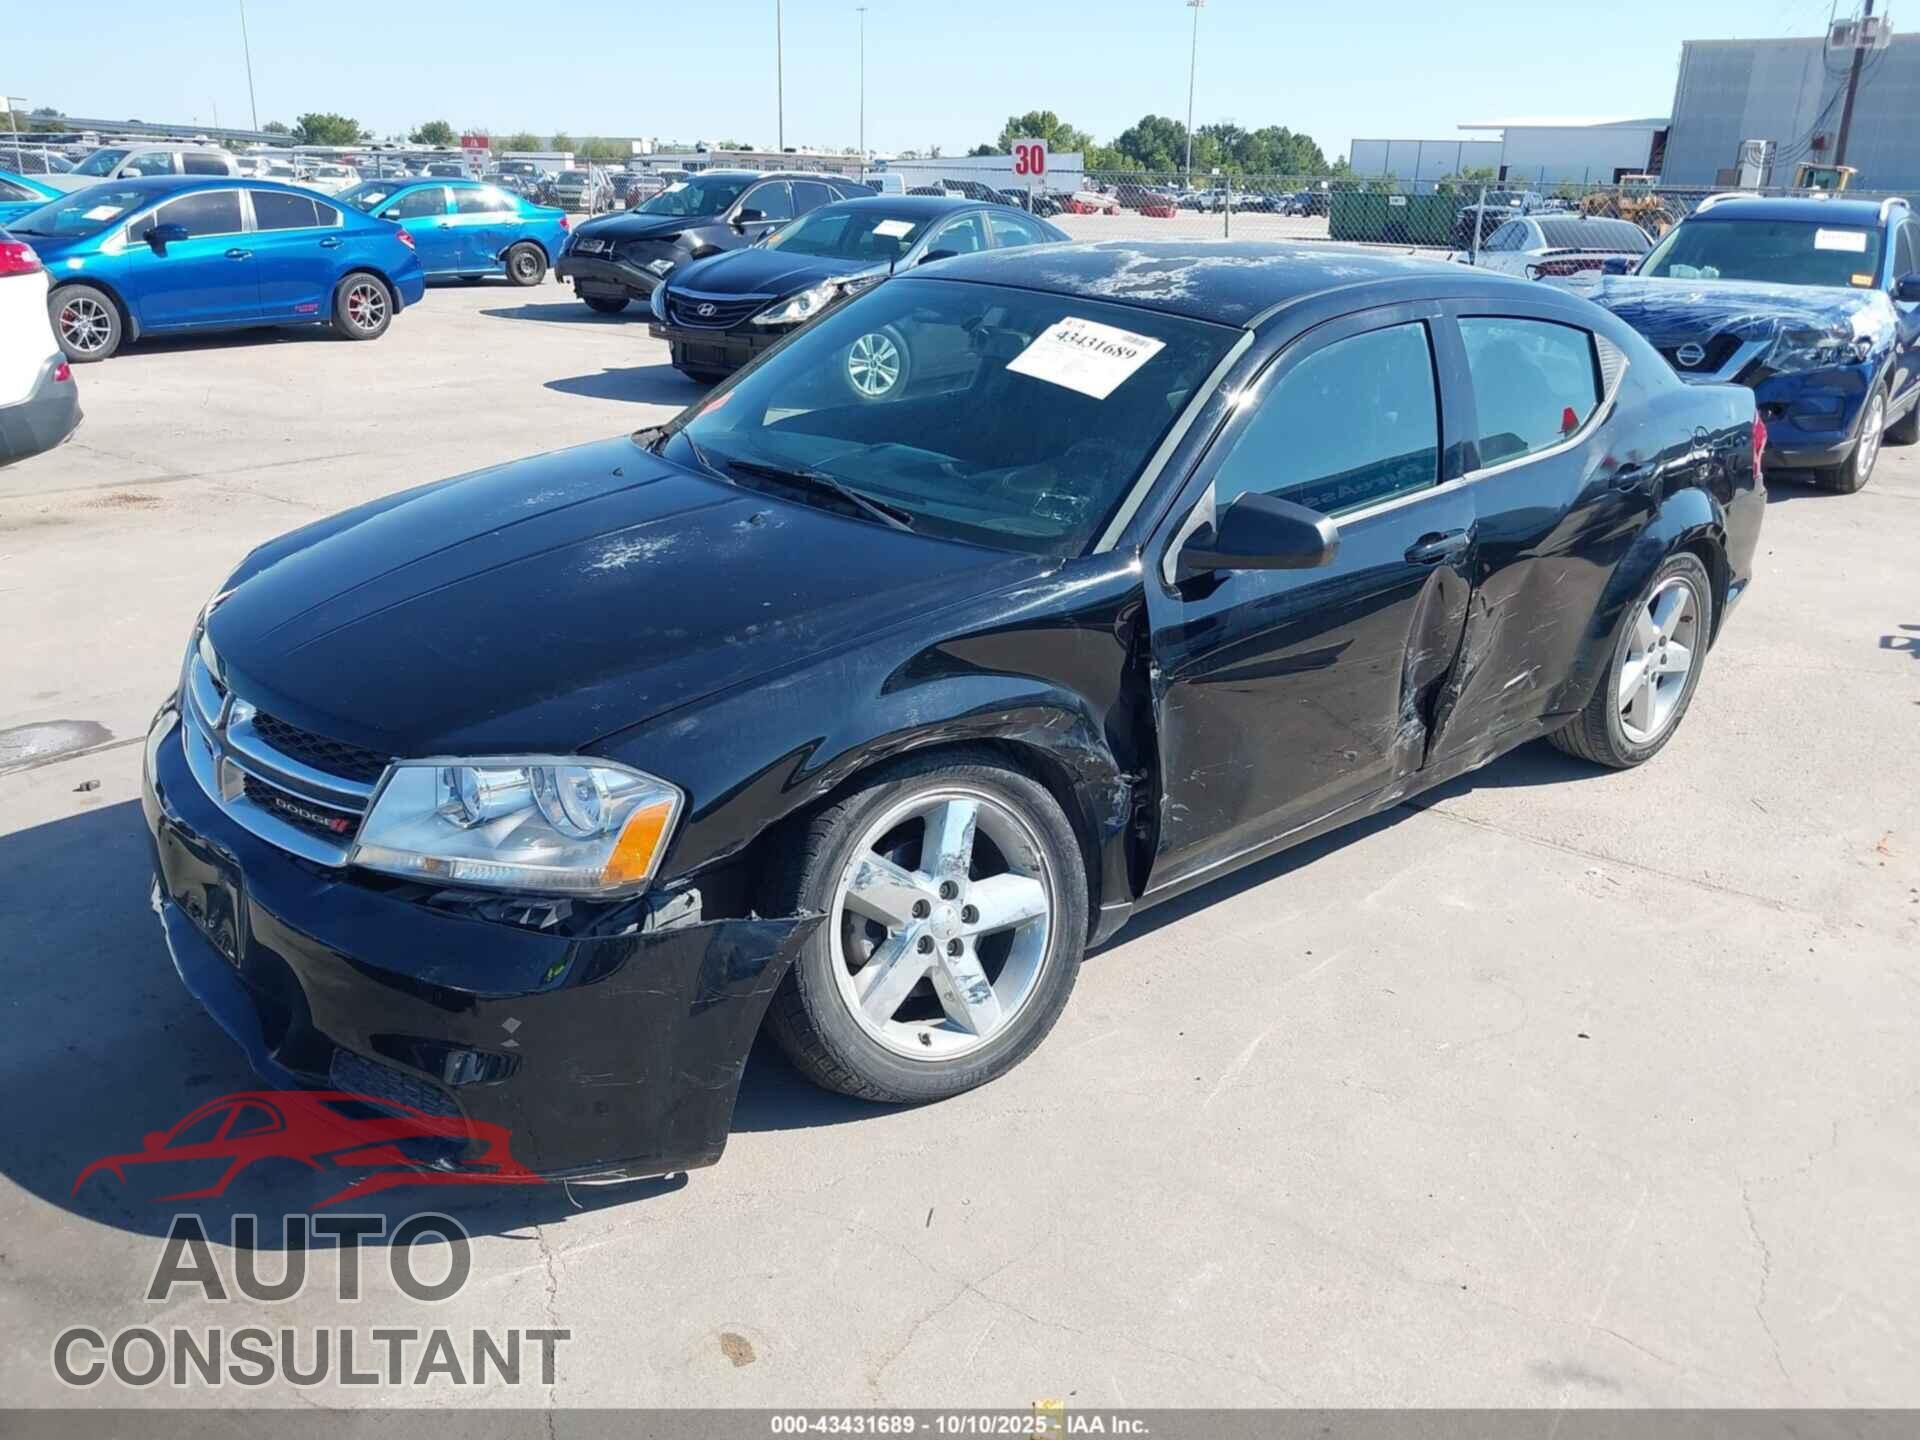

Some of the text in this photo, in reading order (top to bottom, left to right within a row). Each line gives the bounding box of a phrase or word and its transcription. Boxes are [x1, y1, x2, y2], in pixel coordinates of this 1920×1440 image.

[1015, 144, 1044, 175] 30
[1055, 329, 1138, 360] 43431689
[274, 798, 334, 828] DODGE
